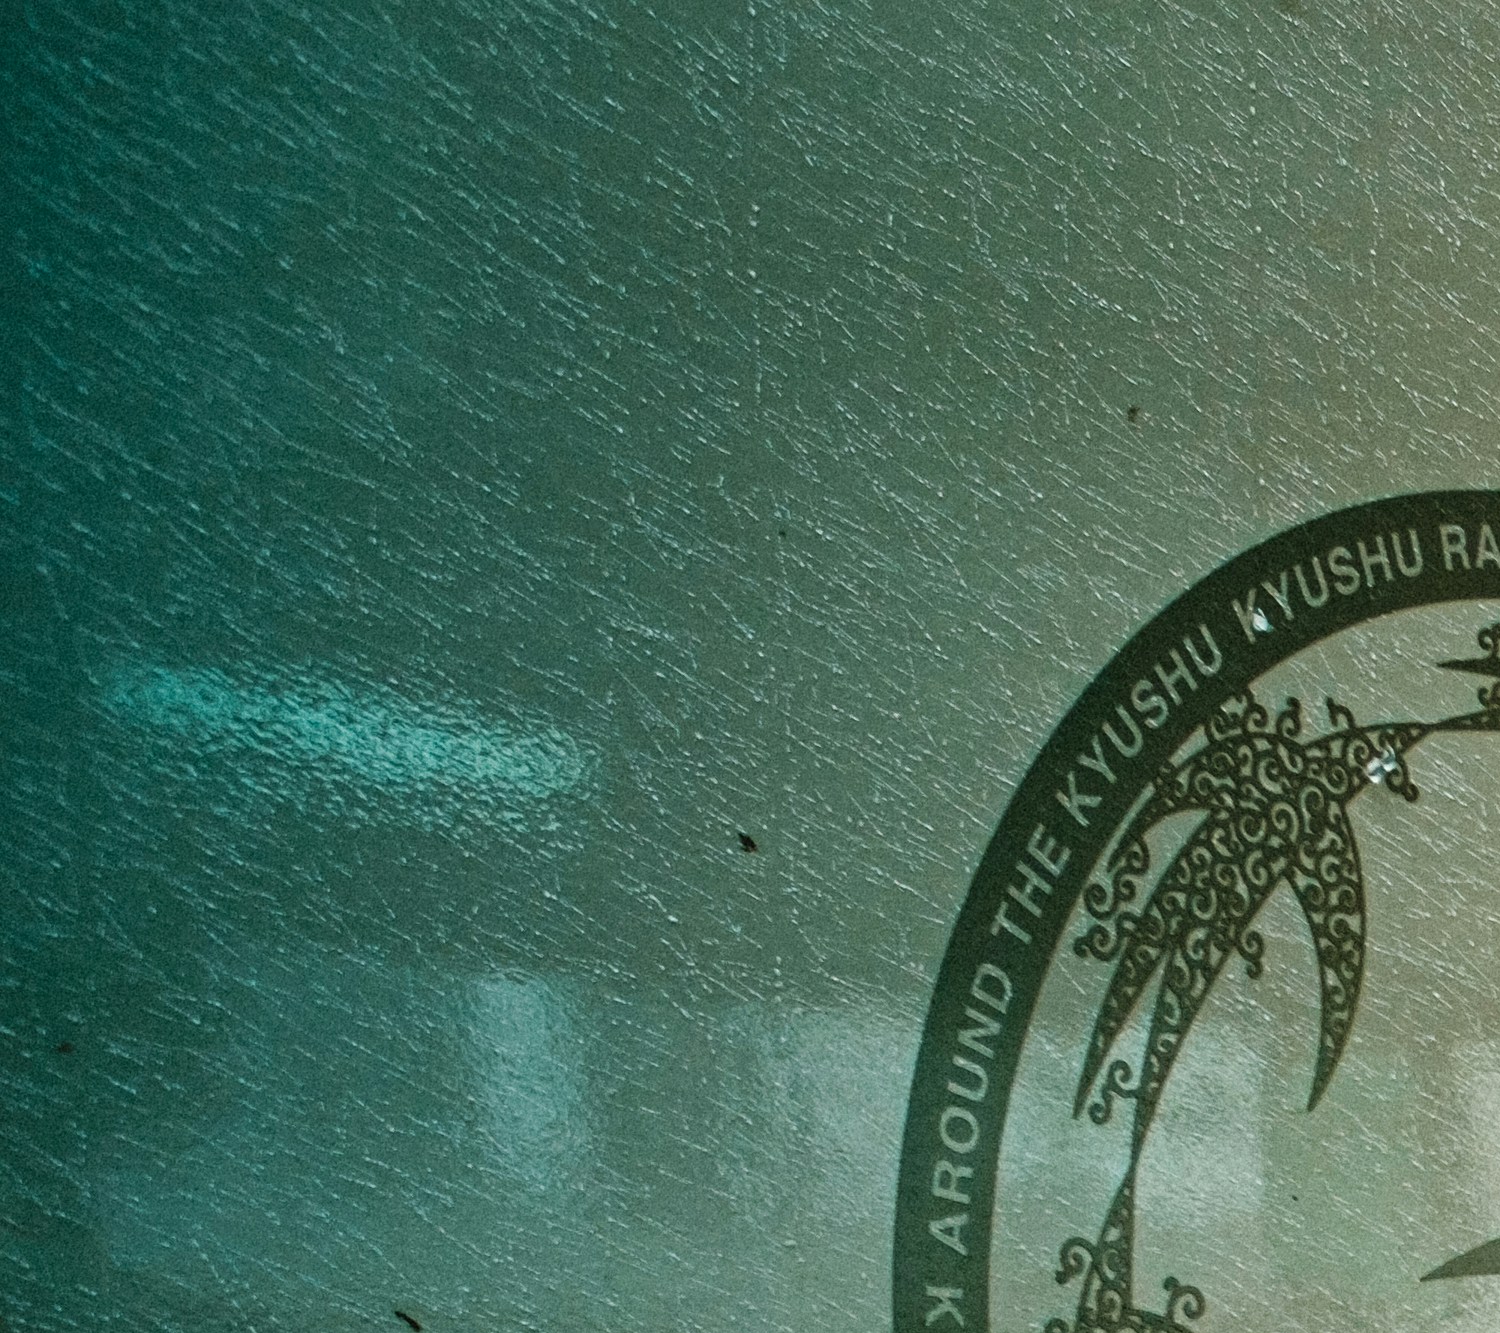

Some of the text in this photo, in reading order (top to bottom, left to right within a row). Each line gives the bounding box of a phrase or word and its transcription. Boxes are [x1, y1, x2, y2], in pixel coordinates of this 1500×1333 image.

[925, 950, 1016, 1255] AROUND
[987, 815, 1071, 957] THE
[1052, 619, 1224, 831] KYUSHU
[1233, 528, 1423, 647] KYUSHU
